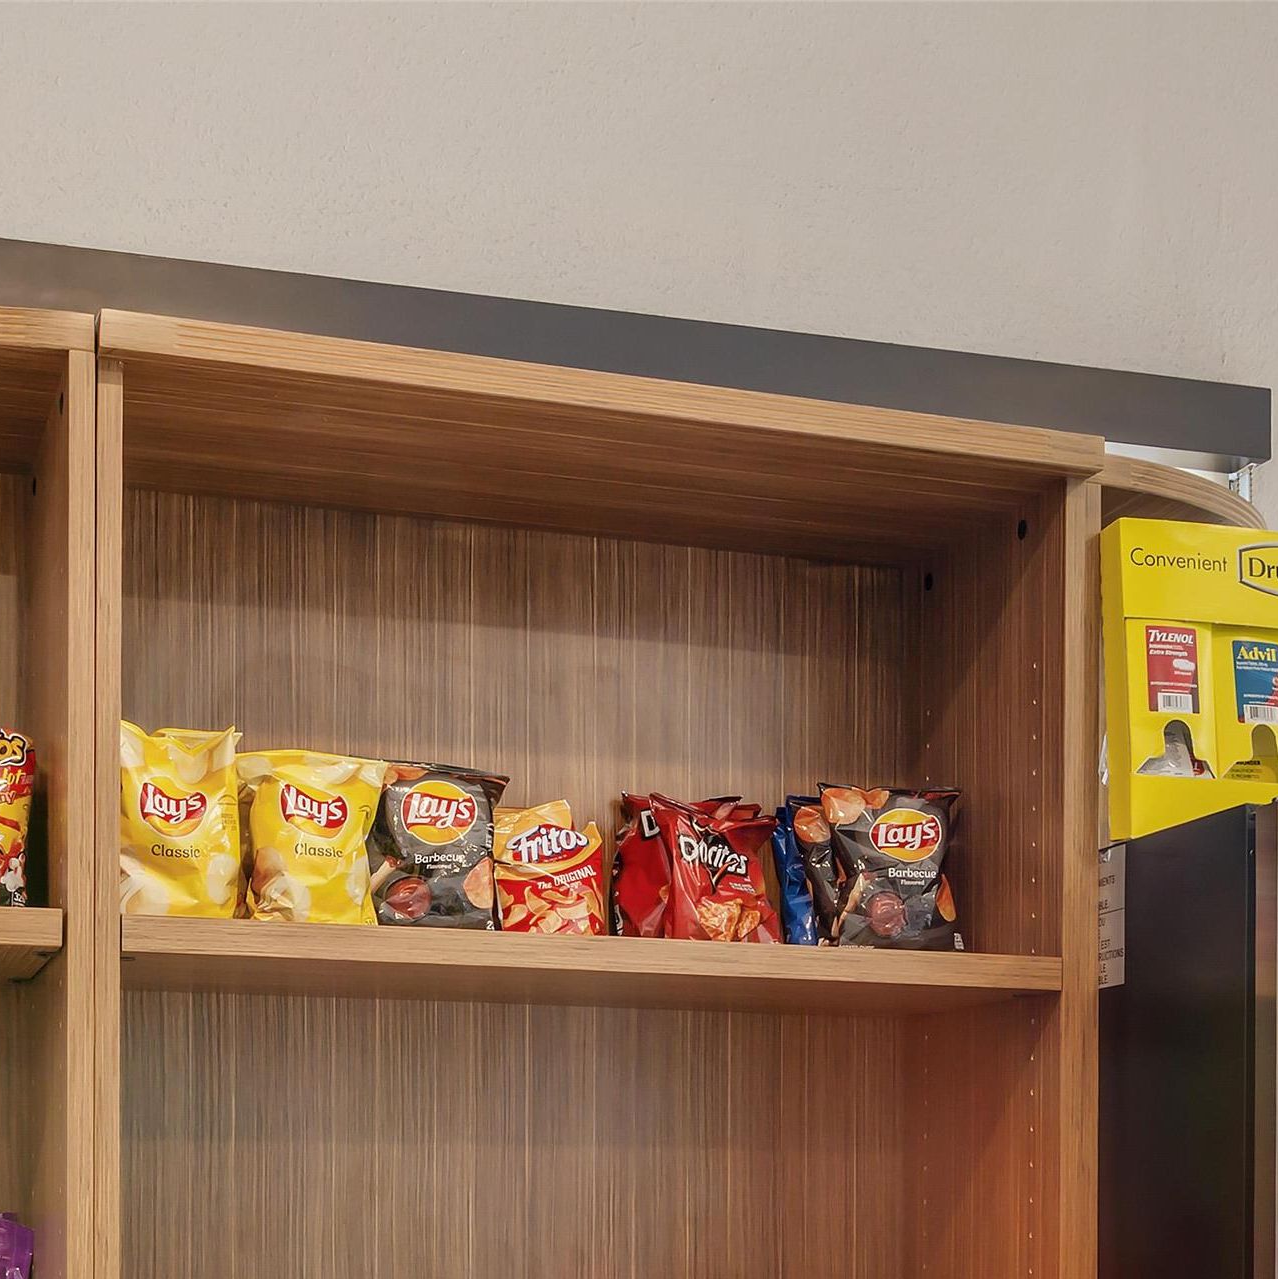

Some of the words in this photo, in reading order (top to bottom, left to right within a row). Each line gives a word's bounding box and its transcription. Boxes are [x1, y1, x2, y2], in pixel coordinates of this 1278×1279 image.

[1130, 547, 1228, 572] Convenient
[1148, 629, 1194, 644] TYLENOL
[1237, 646, 1277, 662] Advil
[144, 782, 202, 824] Lay's
[283, 784, 345, 827] Lay's
[406, 793, 473, 829] Lay's
[506, 824, 589, 865] Fritos
[877, 820, 936, 850] Lay's
[151, 844, 201, 859] Classic
[294, 842, 343, 859] Classic
[414, 852, 466, 864] Barbecue
[678, 833, 749, 876] Doritos
[536, 881, 552, 890] The
[554, 865, 597, 885] ORIGINAL
[888, 867, 937, 878] Barbecue
